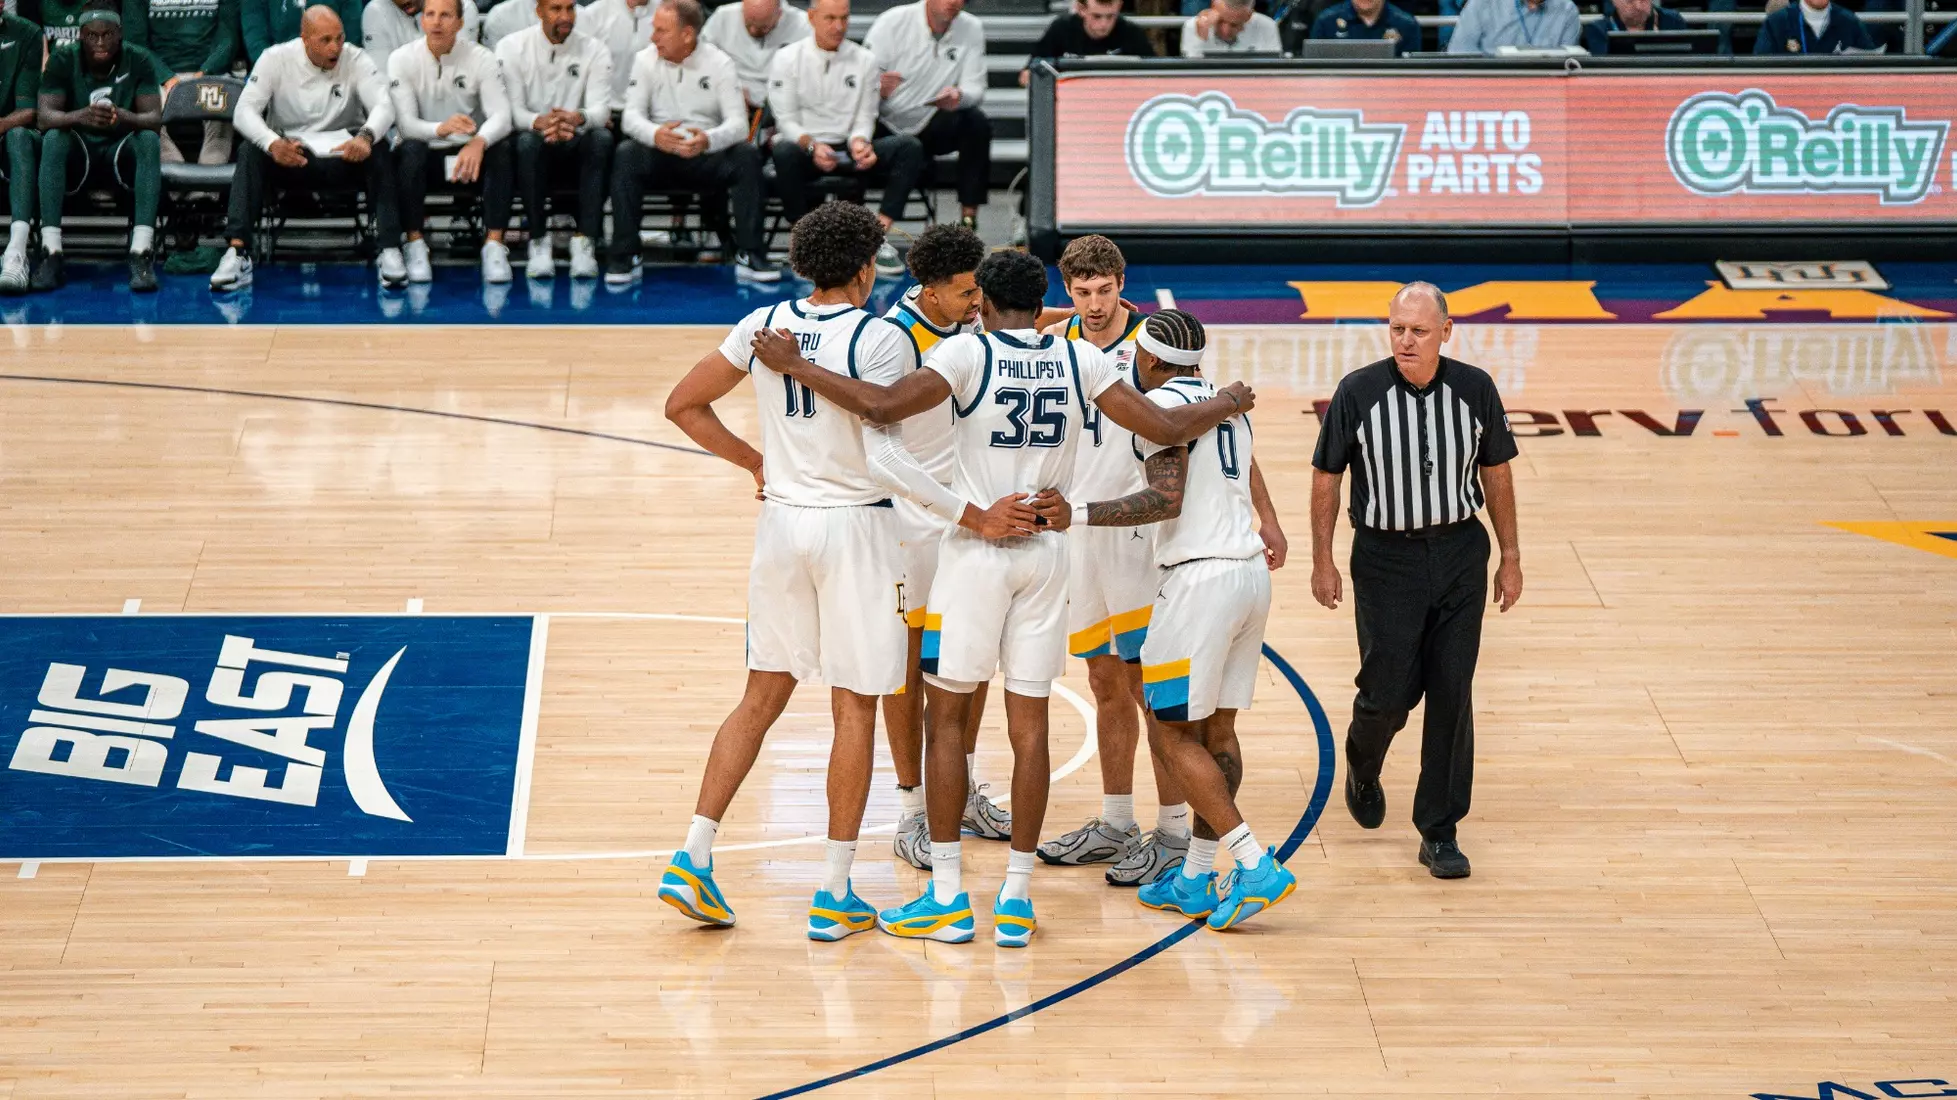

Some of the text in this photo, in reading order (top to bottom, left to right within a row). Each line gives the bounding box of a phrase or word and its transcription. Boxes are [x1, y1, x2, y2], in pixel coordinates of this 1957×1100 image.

[197, 84, 227, 111] MU
[1141, 108, 1386, 191] O'Reilly
[1418, 110, 1532, 151] AUTO
[1681, 105, 1929, 189] O'Reilly
[1406, 153, 1544, 194] PARTS
[998, 359, 1054, 379] PHILLIPS
[989, 386, 1068, 448] 35
[1217, 420, 1240, 480] 0
[8, 662, 190, 788] BIG
[176, 634, 348, 807] EAST
